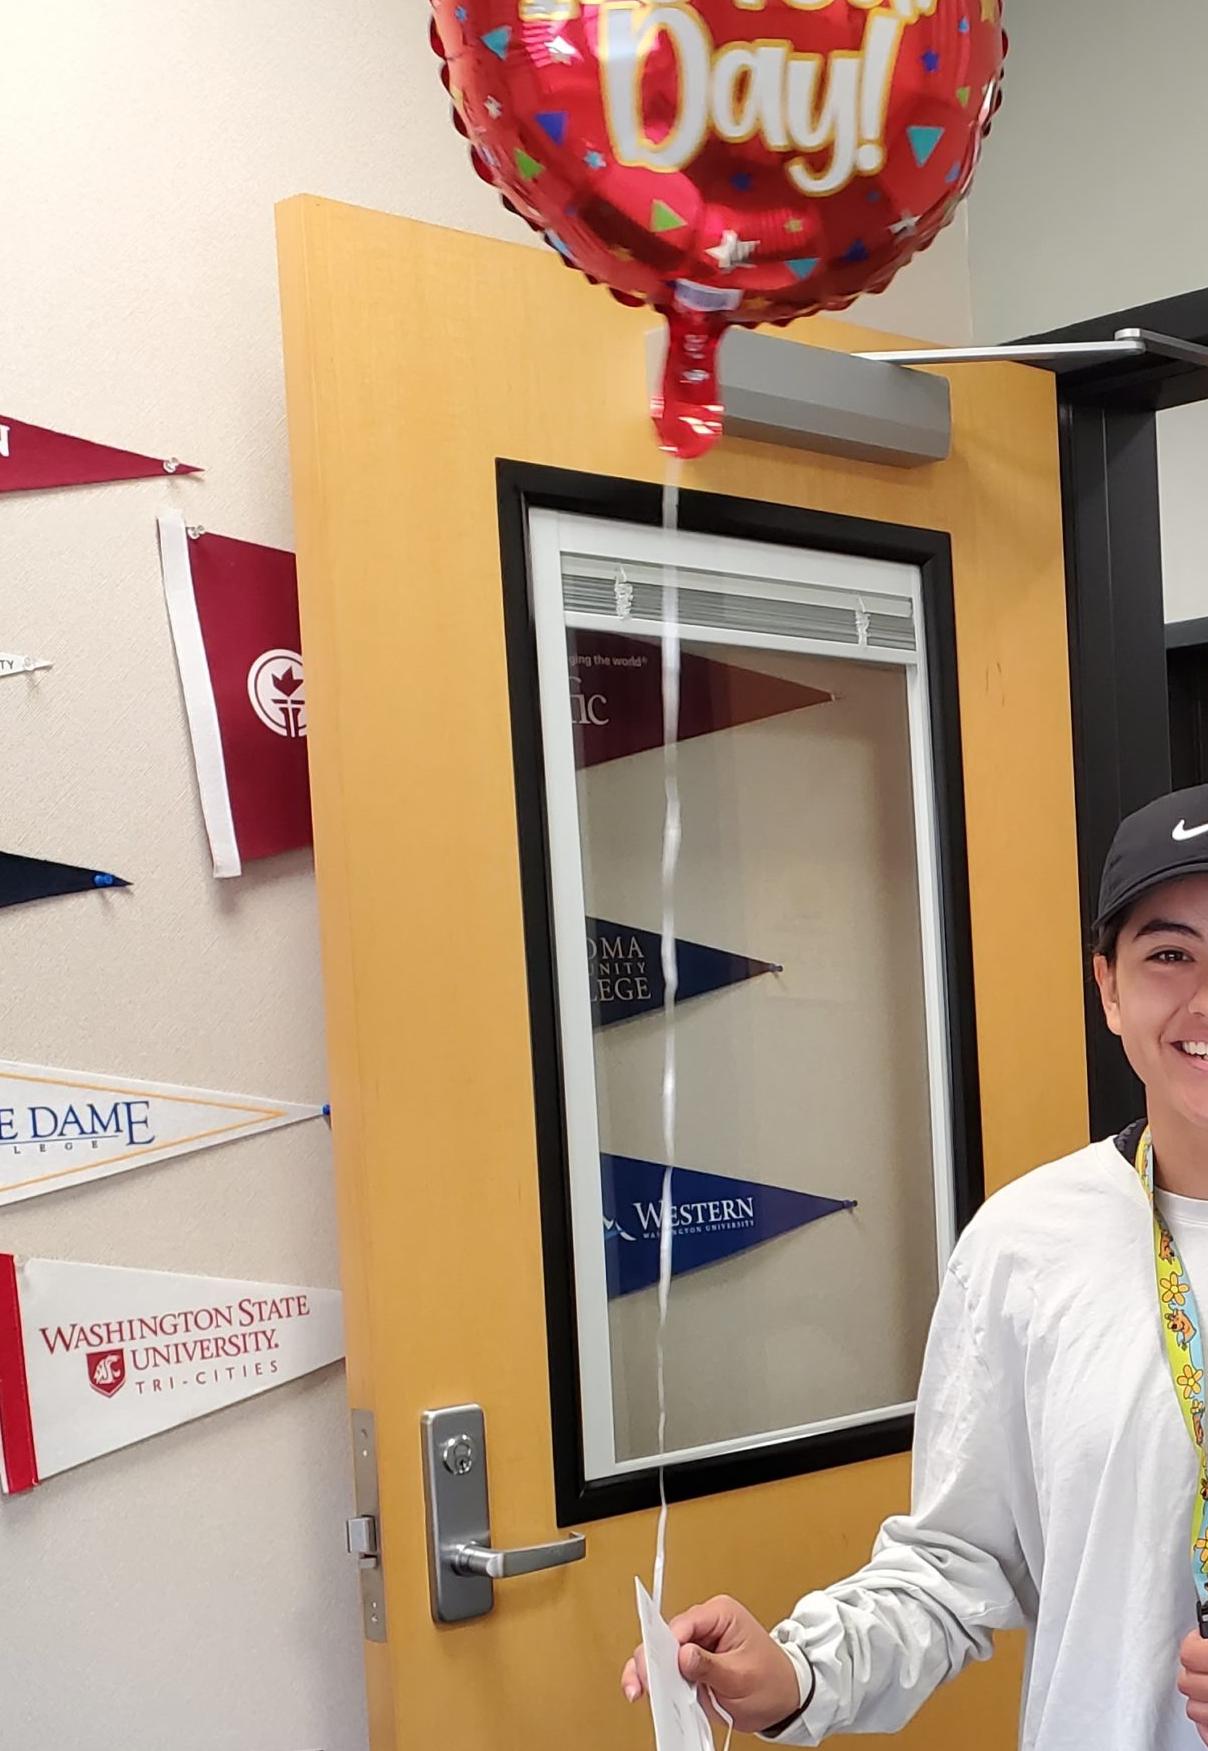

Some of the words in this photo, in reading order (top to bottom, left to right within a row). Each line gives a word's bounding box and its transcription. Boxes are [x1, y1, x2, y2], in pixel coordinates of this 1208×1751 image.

[599, 4, 900, 196] Day!
[594, 654, 610, 666] the
[569, 675, 609, 725] ic
[590, 977, 651, 1002] EGE
[28, 1100, 156, 1146] DAME
[633, 1197, 754, 1231] WESTERN
[643, 1226, 701, 1239] WANGTON
[705, 1220, 754, 1233] UNIVERSITY
[39, 1305, 233, 1355] WASHINGTON
[238, 1295, 310, 1327] STATE
[136, 1360, 278, 1395] TRI-CITIES
